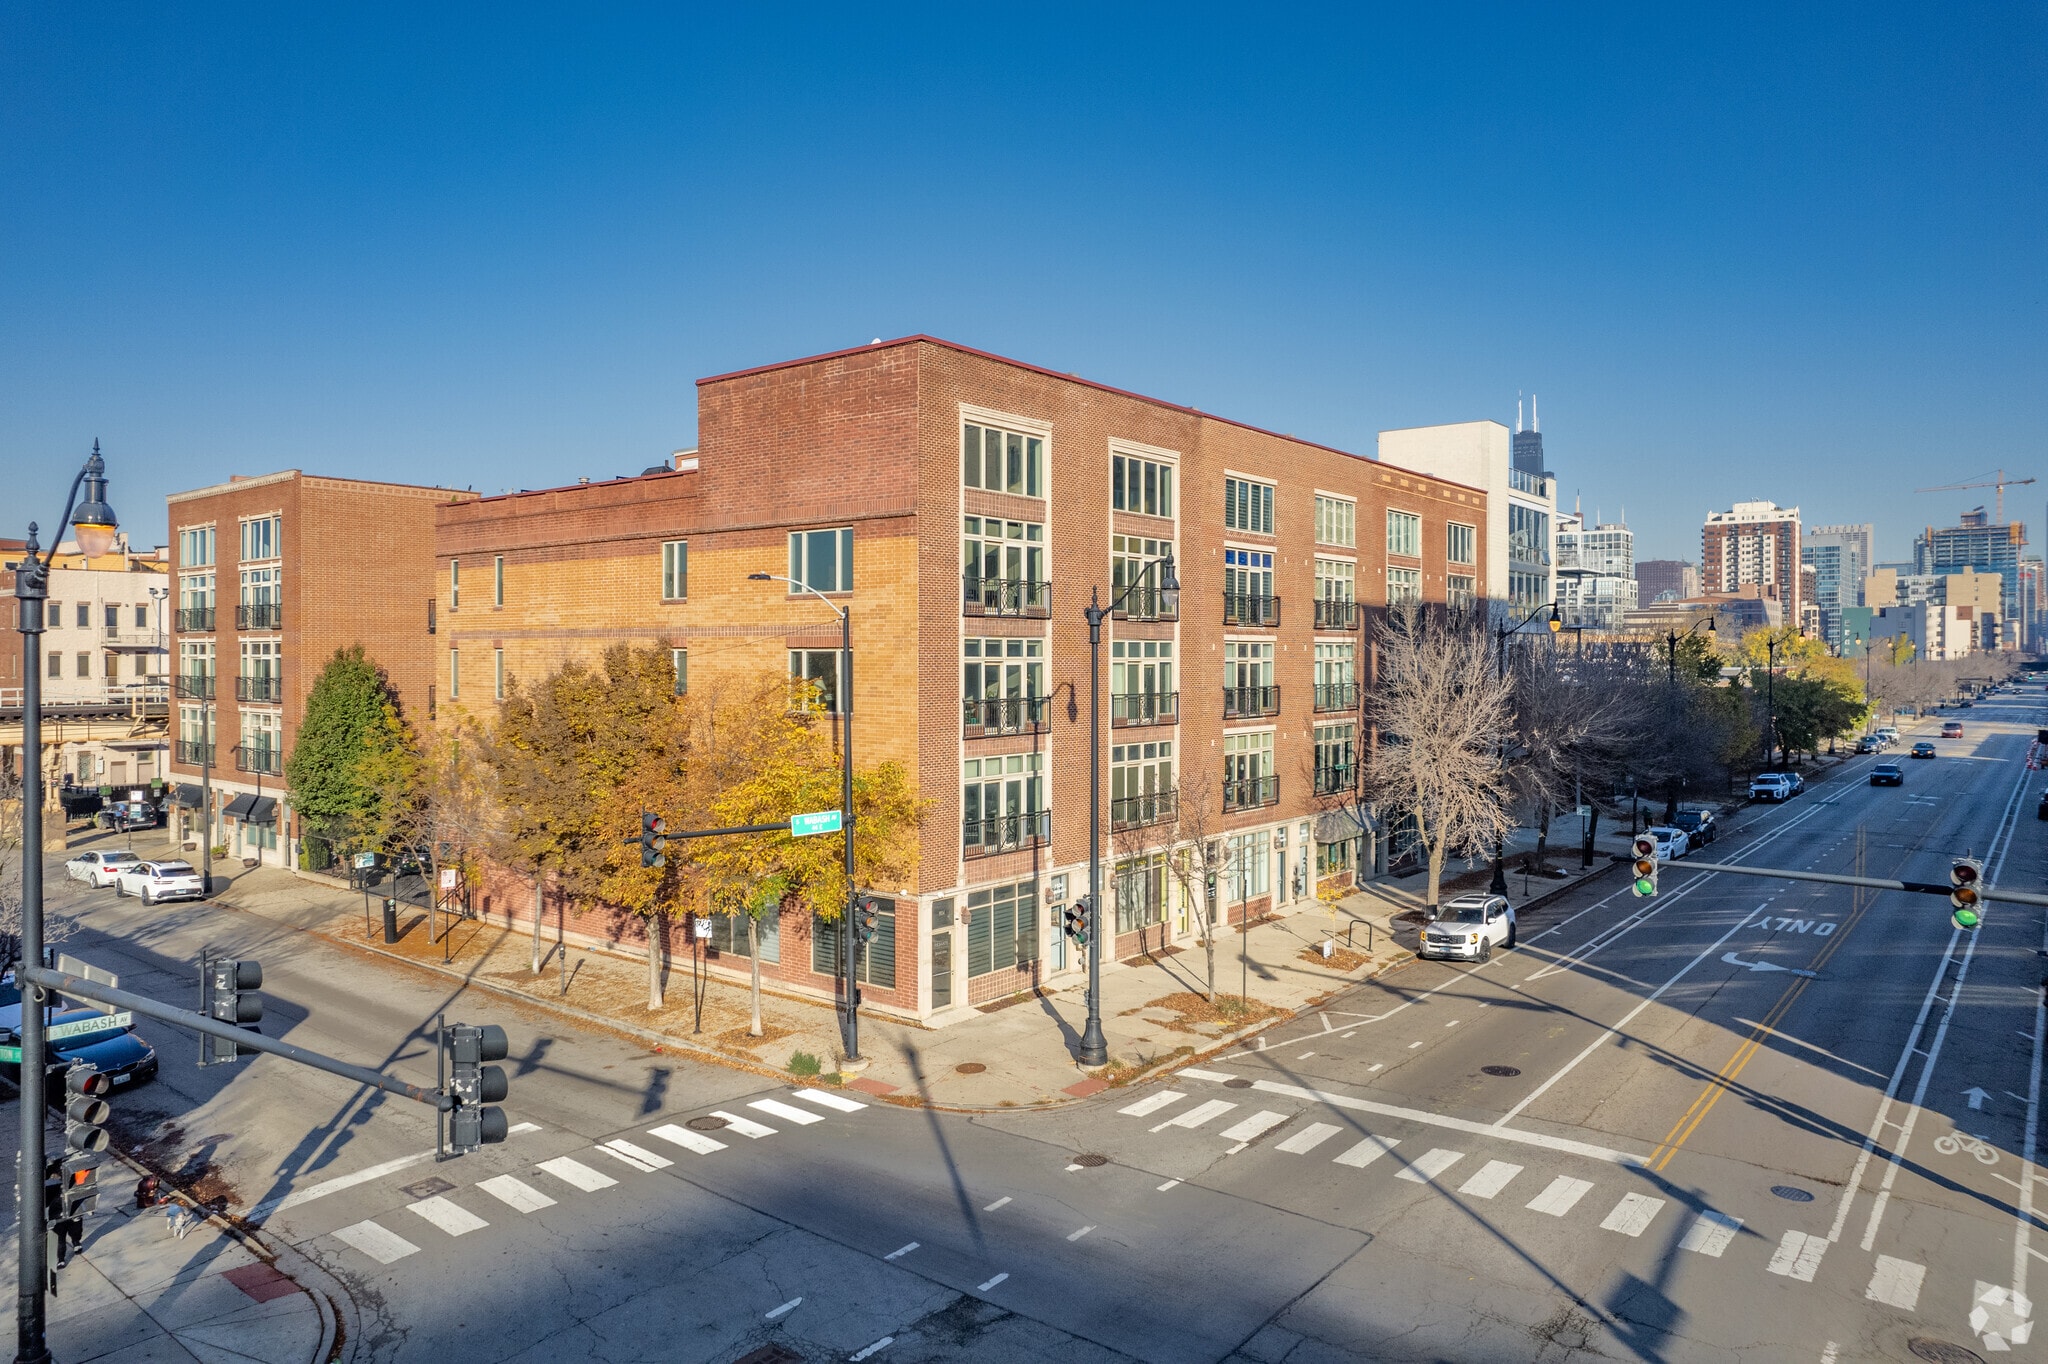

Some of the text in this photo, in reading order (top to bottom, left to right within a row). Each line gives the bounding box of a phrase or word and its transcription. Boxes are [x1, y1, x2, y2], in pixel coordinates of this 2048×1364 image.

[804, 815, 830, 825] WABASH
[1747, 916, 1838, 937] ONLY
[61, 1016, 117, 1036] WABASH
